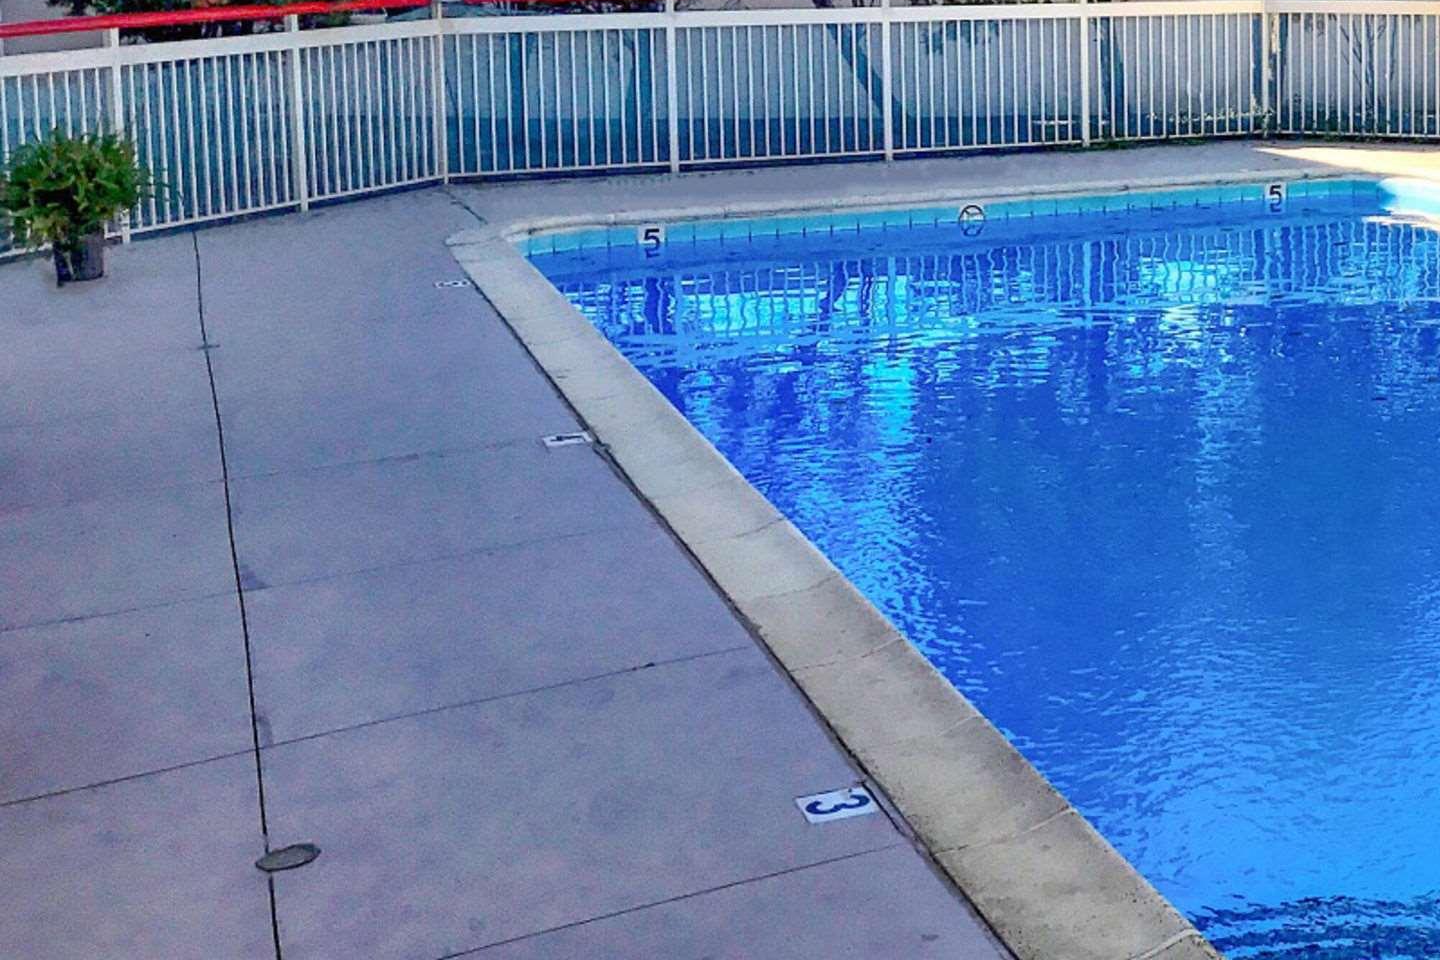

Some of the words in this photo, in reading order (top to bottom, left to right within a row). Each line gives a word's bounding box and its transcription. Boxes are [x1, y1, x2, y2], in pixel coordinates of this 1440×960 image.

[1269, 185, 1282, 202] 5
[644, 228, 660, 248] 5
[805, 794, 870, 815] 3
